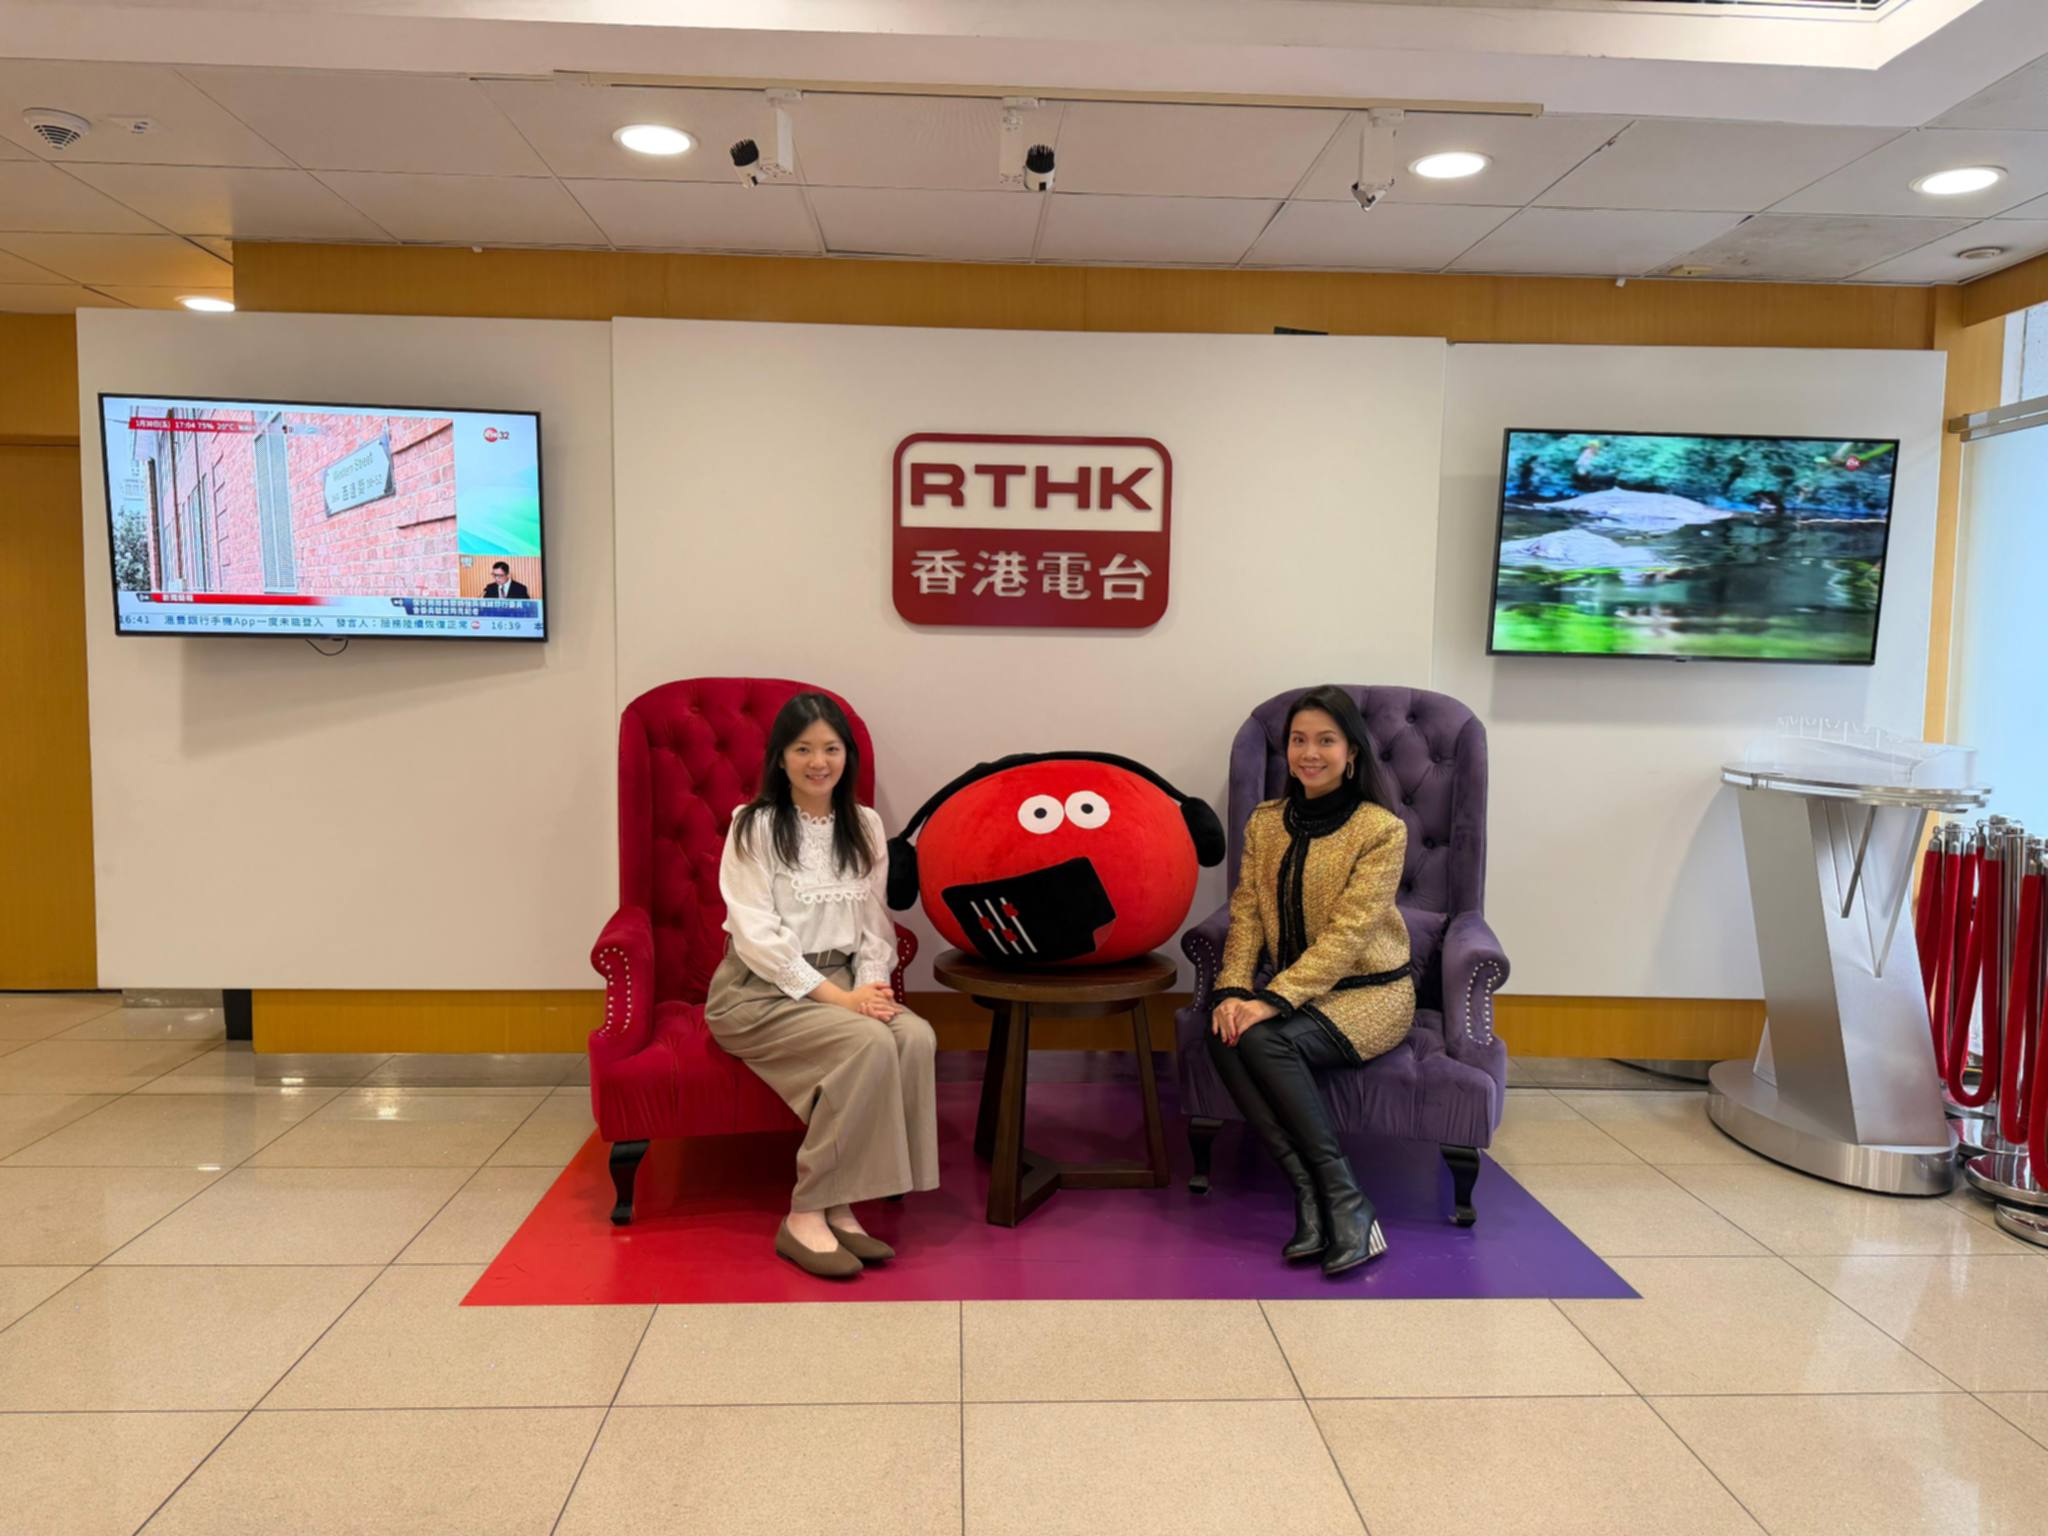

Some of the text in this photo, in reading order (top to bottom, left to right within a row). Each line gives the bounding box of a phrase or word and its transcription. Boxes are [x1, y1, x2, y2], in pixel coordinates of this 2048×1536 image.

[176, 421, 195, 429] 17:04
[910, 462, 1154, 511] RTHK
[910, 548, 1153, 601] 香港電台
[119, 616, 150, 625] 16:41
[491, 621, 521, 631] 16:39
